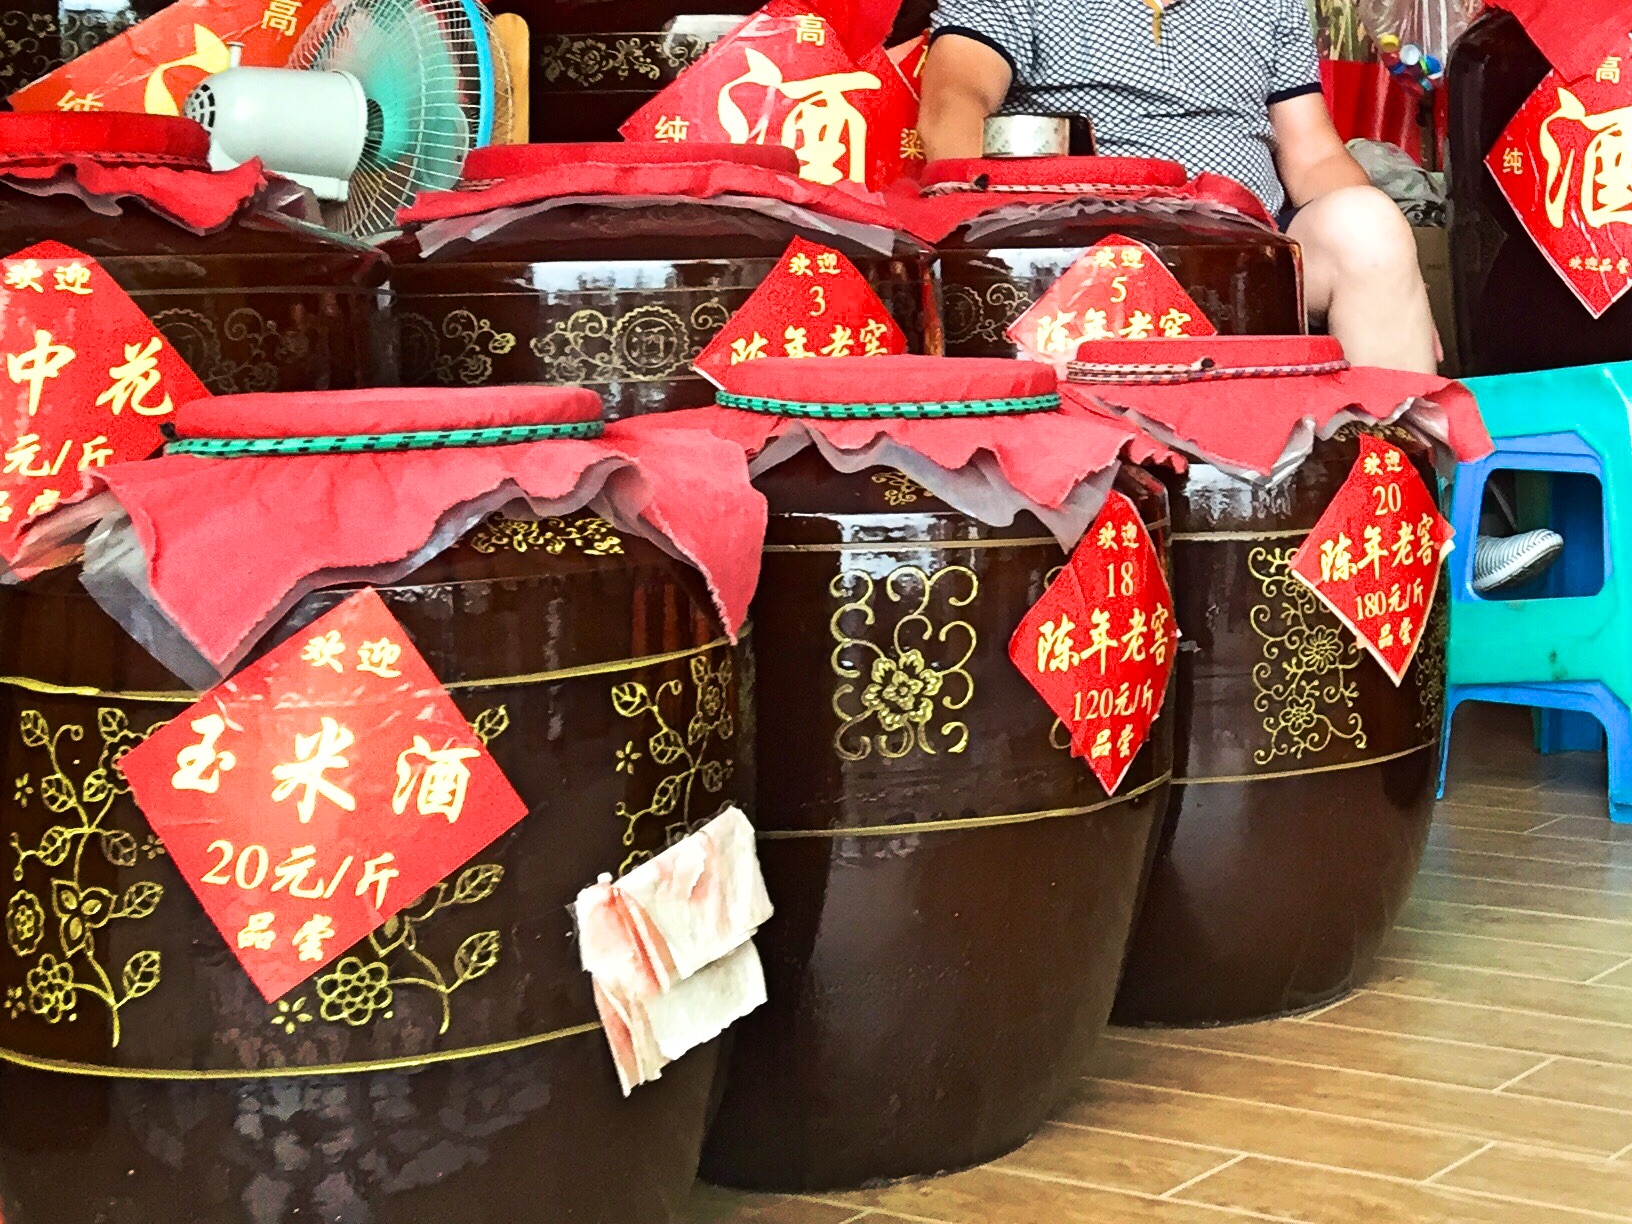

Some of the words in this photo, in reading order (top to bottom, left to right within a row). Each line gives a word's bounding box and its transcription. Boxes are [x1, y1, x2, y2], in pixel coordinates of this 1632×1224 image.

[796, 14, 825, 46] 高
[1596, 56, 1621, 84] 高
[655, 115, 690, 143] 纯
[717, 48, 881, 184] 酒
[1503, 147, 1524, 175] 纯
[789, 253, 841, 276] 欢迎
[1093, 248, 1143, 270] 欢迎
[6, 259, 93, 294] 欢迎
[1109, 276, 1126, 303] 5
[809, 287, 826, 316] 3
[7, 329, 174, 416] 中花
[1362, 449, 1402, 475] 欢迎
[1371, 483, 1402, 516] 20
[1097, 519, 1139, 551] 欢迎
[1320, 512, 1435, 583] 陈年老窖
[1106, 562, 1134, 598] 18
[1354, 577, 1424, 621] 180元/斤
[1036, 602, 1170, 676] 陈年老窖
[1377, 618, 1413, 649] 品尝
[300, 631, 402, 678] 欢迎
[1072, 688, 1153, 724] 120元/斤
[1090, 726, 1135, 760] 品尝
[172, 716, 482, 824] 玉米酒
[199, 839, 400, 907] 20元/斤
[235, 913, 336, 963] 品尝
